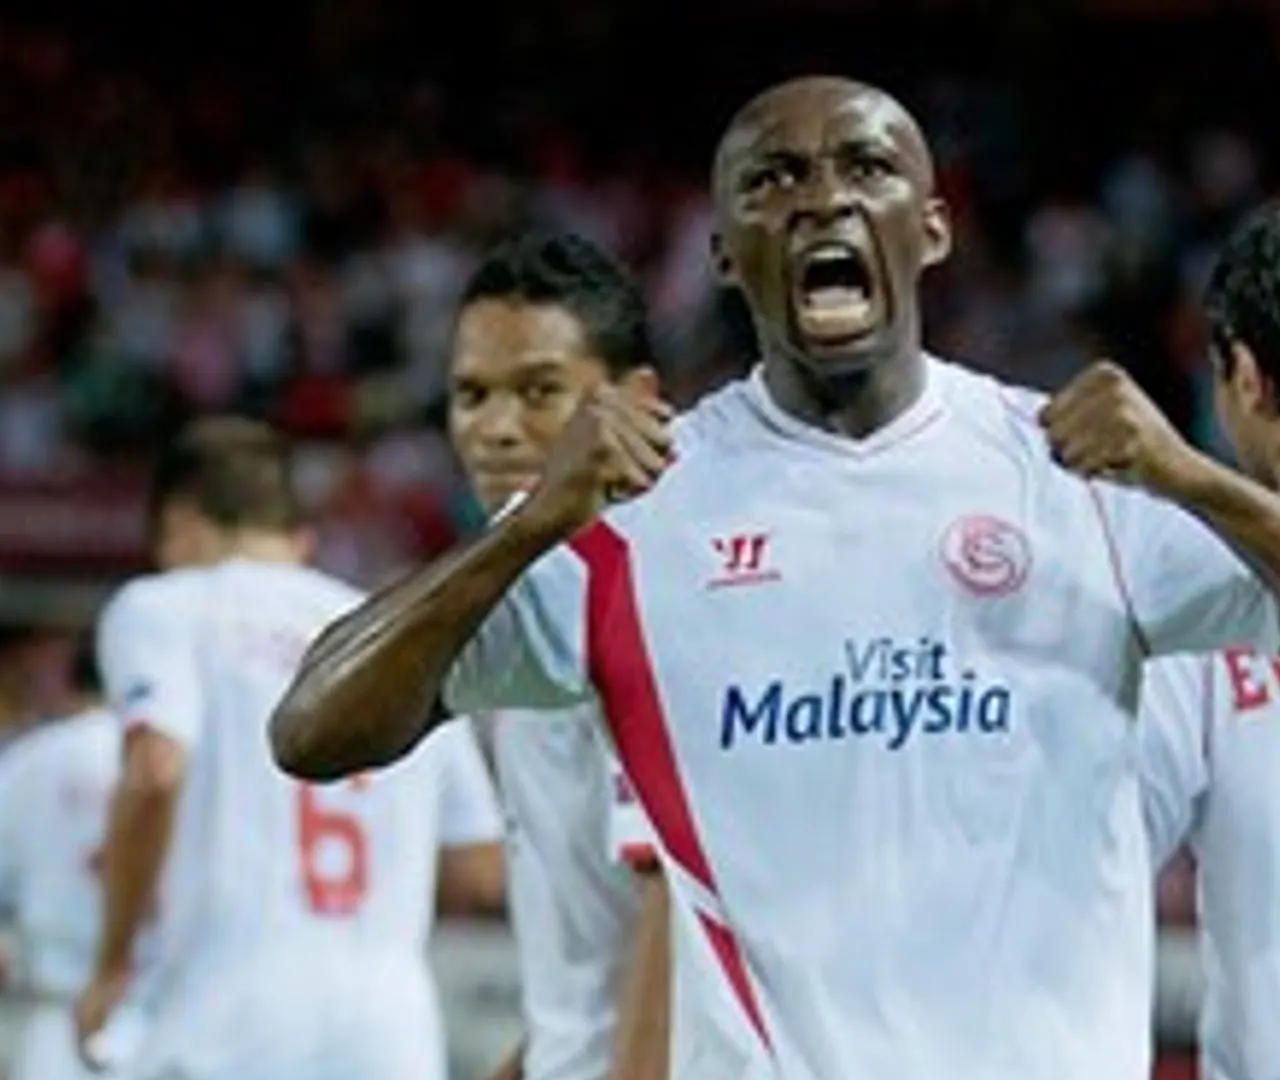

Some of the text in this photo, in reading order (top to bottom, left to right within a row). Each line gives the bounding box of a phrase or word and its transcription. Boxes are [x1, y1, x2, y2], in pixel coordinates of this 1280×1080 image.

[844, 636, 947, 681] Visit
[719, 670, 1011, 750] Malaysia
[296, 770, 370, 917] 6
